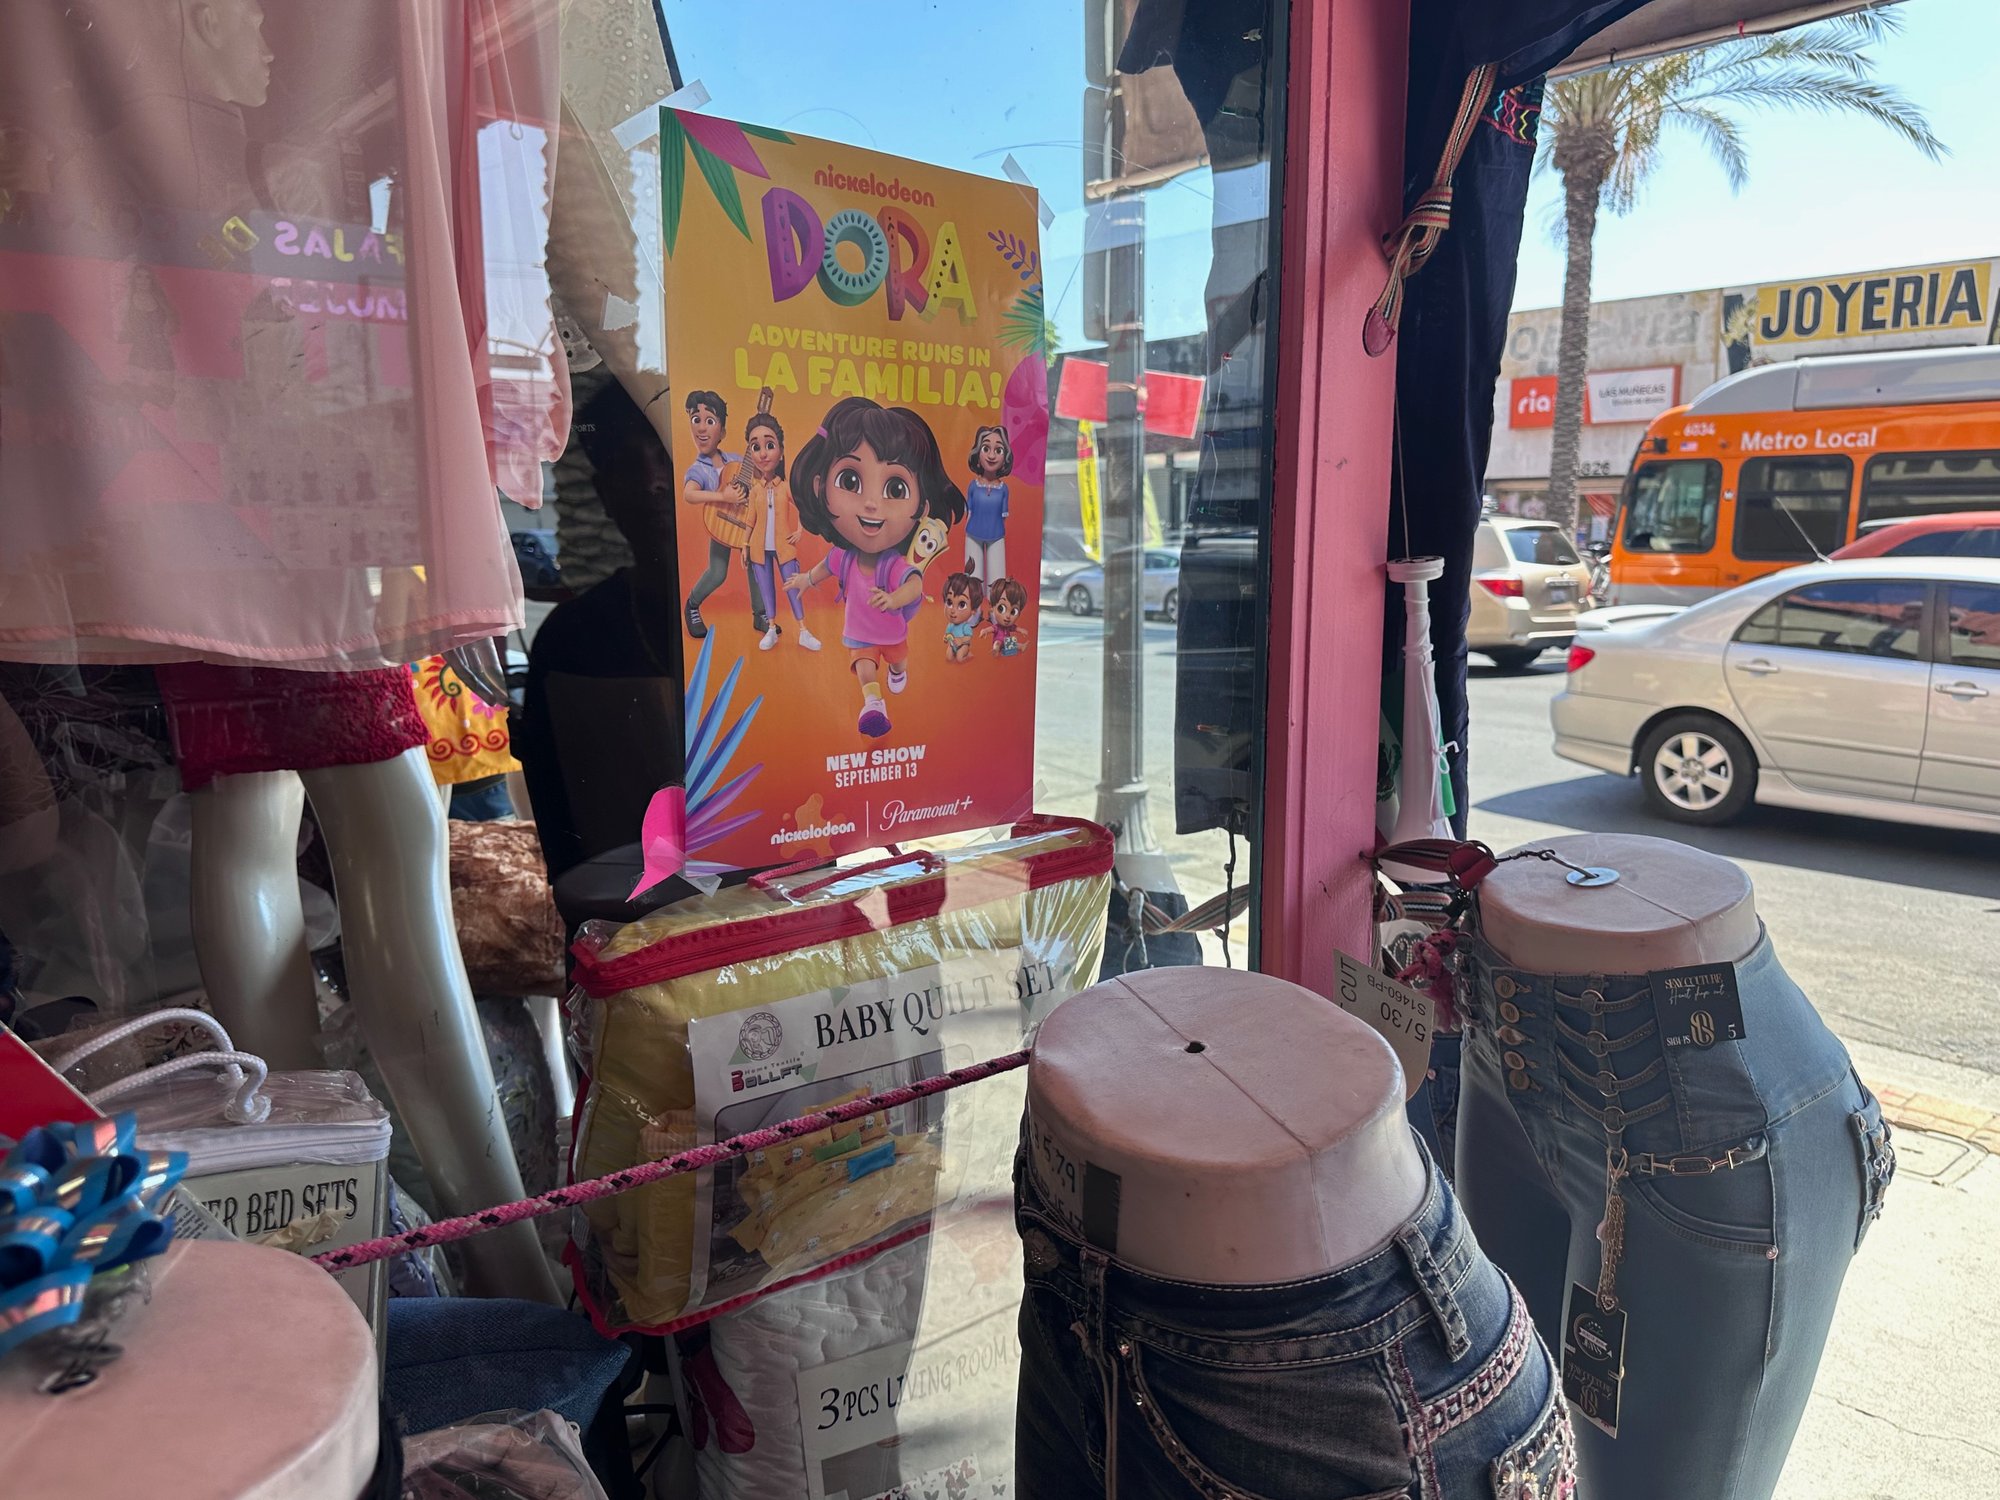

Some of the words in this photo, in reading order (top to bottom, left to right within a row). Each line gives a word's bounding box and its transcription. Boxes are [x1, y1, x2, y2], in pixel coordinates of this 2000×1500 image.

[813, 164, 936, 207] nickelodeon
[761, 186, 978, 327] DORA
[1760, 268, 1984, 340] JOYERIA
[747, 323, 897, 359] ADVENTURE
[903, 341, 964, 367] RUNS
[968, 347, 991, 368] IN
[734, 347, 799, 394] LA
[807, 355, 1002, 410] FAMILIA!
[1517, 386, 1551, 415] ria
[1740, 431, 1808, 451] Metro
[1814, 426, 1879, 449] Local
[826, 751, 868, 772] NEW
[871, 744, 927, 766] SHOW
[835, 764, 902, 788] SEPTEMBER
[905, 762, 918, 778] 13
[770, 821, 856, 845] nickelodeon
[879, 795, 974, 832] Paramount+
[1340, 957, 1357, 1003] CUT
[1367, 974, 1427, 1016] S1460-PB
[813, 998, 896, 1049] BABY
[902, 974, 995, 1036] QUILT
[1006, 960, 1058, 1001] SET
[1728, 1023, 1737, 1039] 5
[246, 1188, 294, 1236] BED
[887, 1360, 952, 1408] LIVING
[956, 1335, 1008, 1386] ROOM
